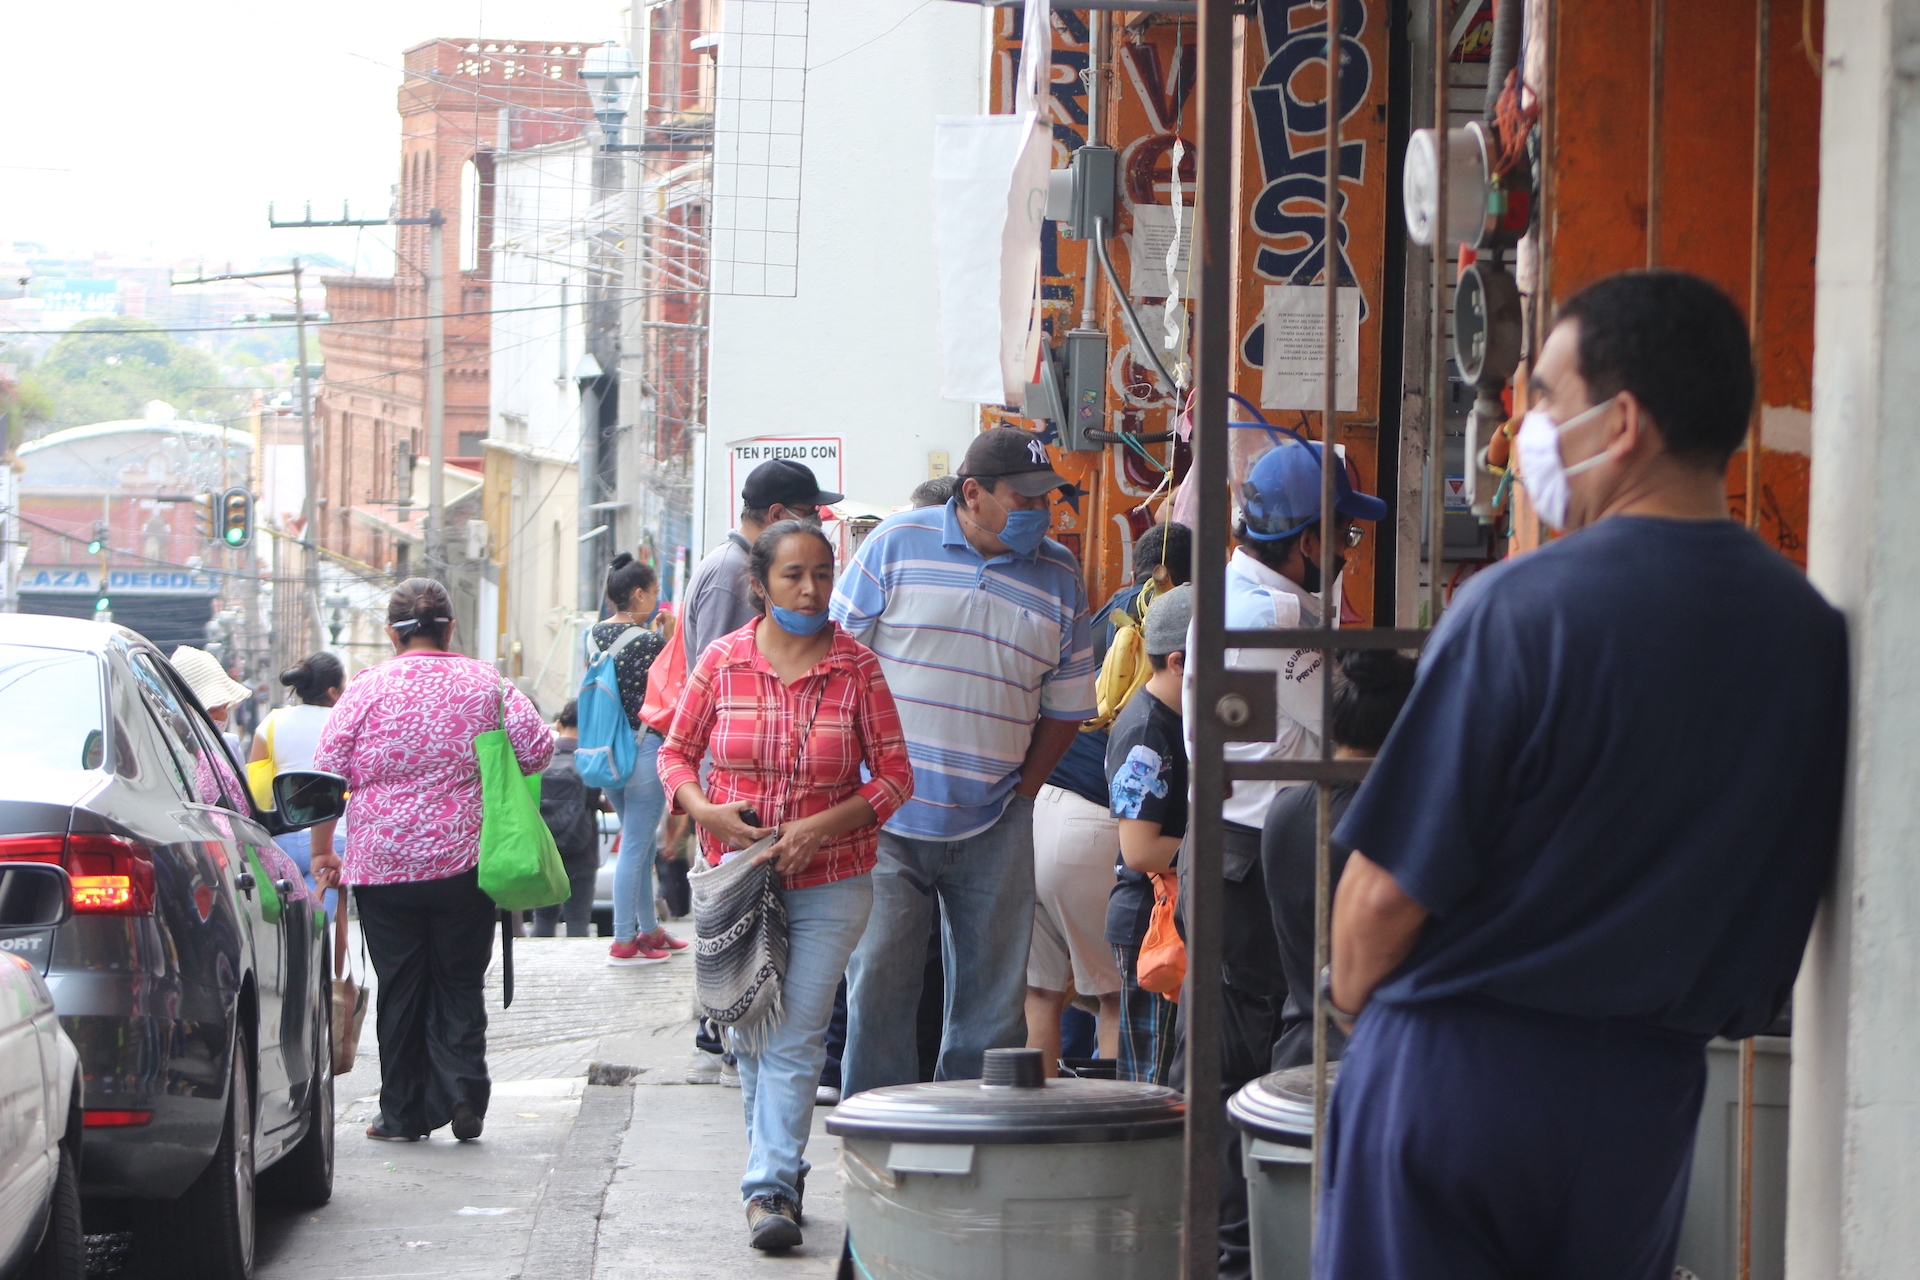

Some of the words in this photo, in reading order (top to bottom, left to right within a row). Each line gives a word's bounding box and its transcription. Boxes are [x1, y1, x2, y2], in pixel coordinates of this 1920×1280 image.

[735, 447, 760, 459] TEN
[763, 446, 807, 459] PIEDAD
[811, 446, 837, 458] CON
[22, 570, 91, 587] AZA
[0, 937, 43, 951] ORT
